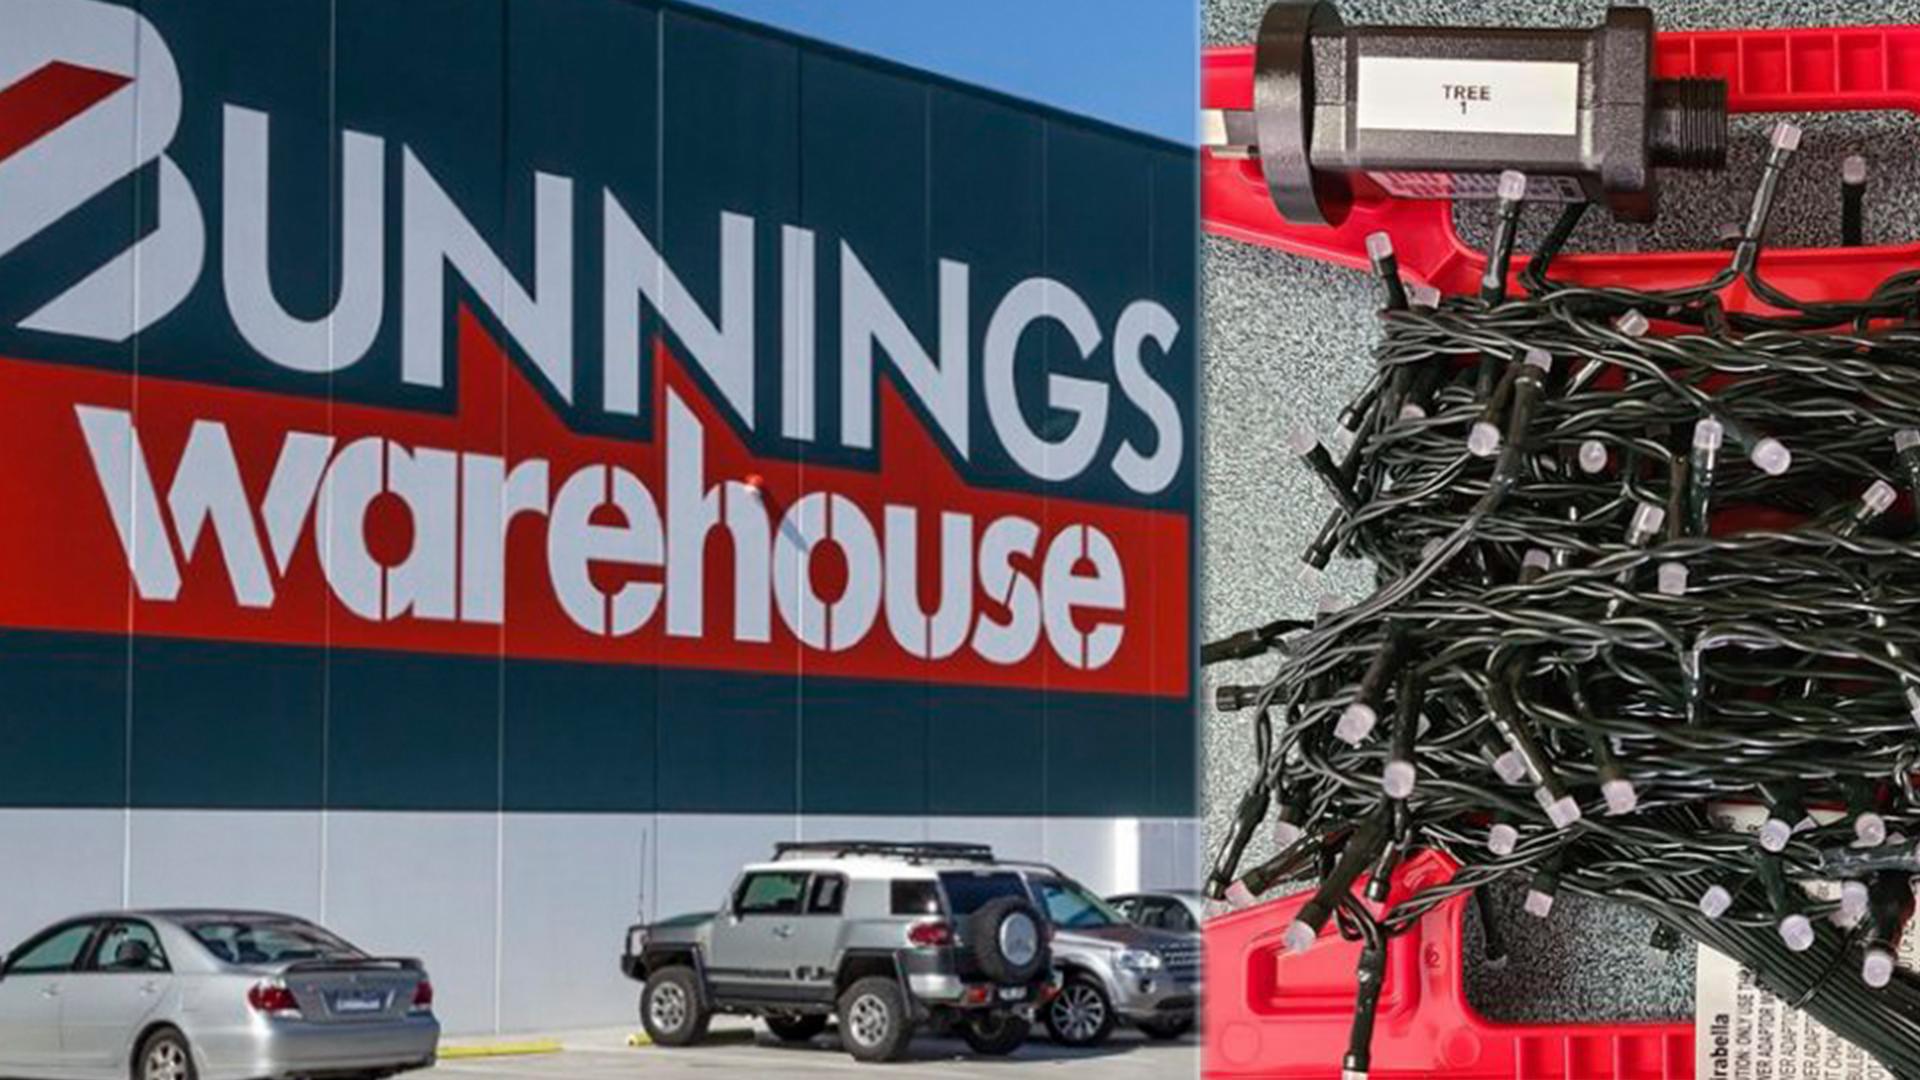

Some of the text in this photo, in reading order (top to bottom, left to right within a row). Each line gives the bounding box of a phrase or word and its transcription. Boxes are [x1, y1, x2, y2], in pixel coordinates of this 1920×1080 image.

[1442, 84, 1492, 101] TREE
[1460, 101, 1467, 115] 1
[0, 0, 1184, 494] BUNNINGS
[73, 384, 1126, 671] warehouse
[1735, 1016, 1752, 1045] ONLY
[1758, 1008, 1774, 1057] ADAPTOR
